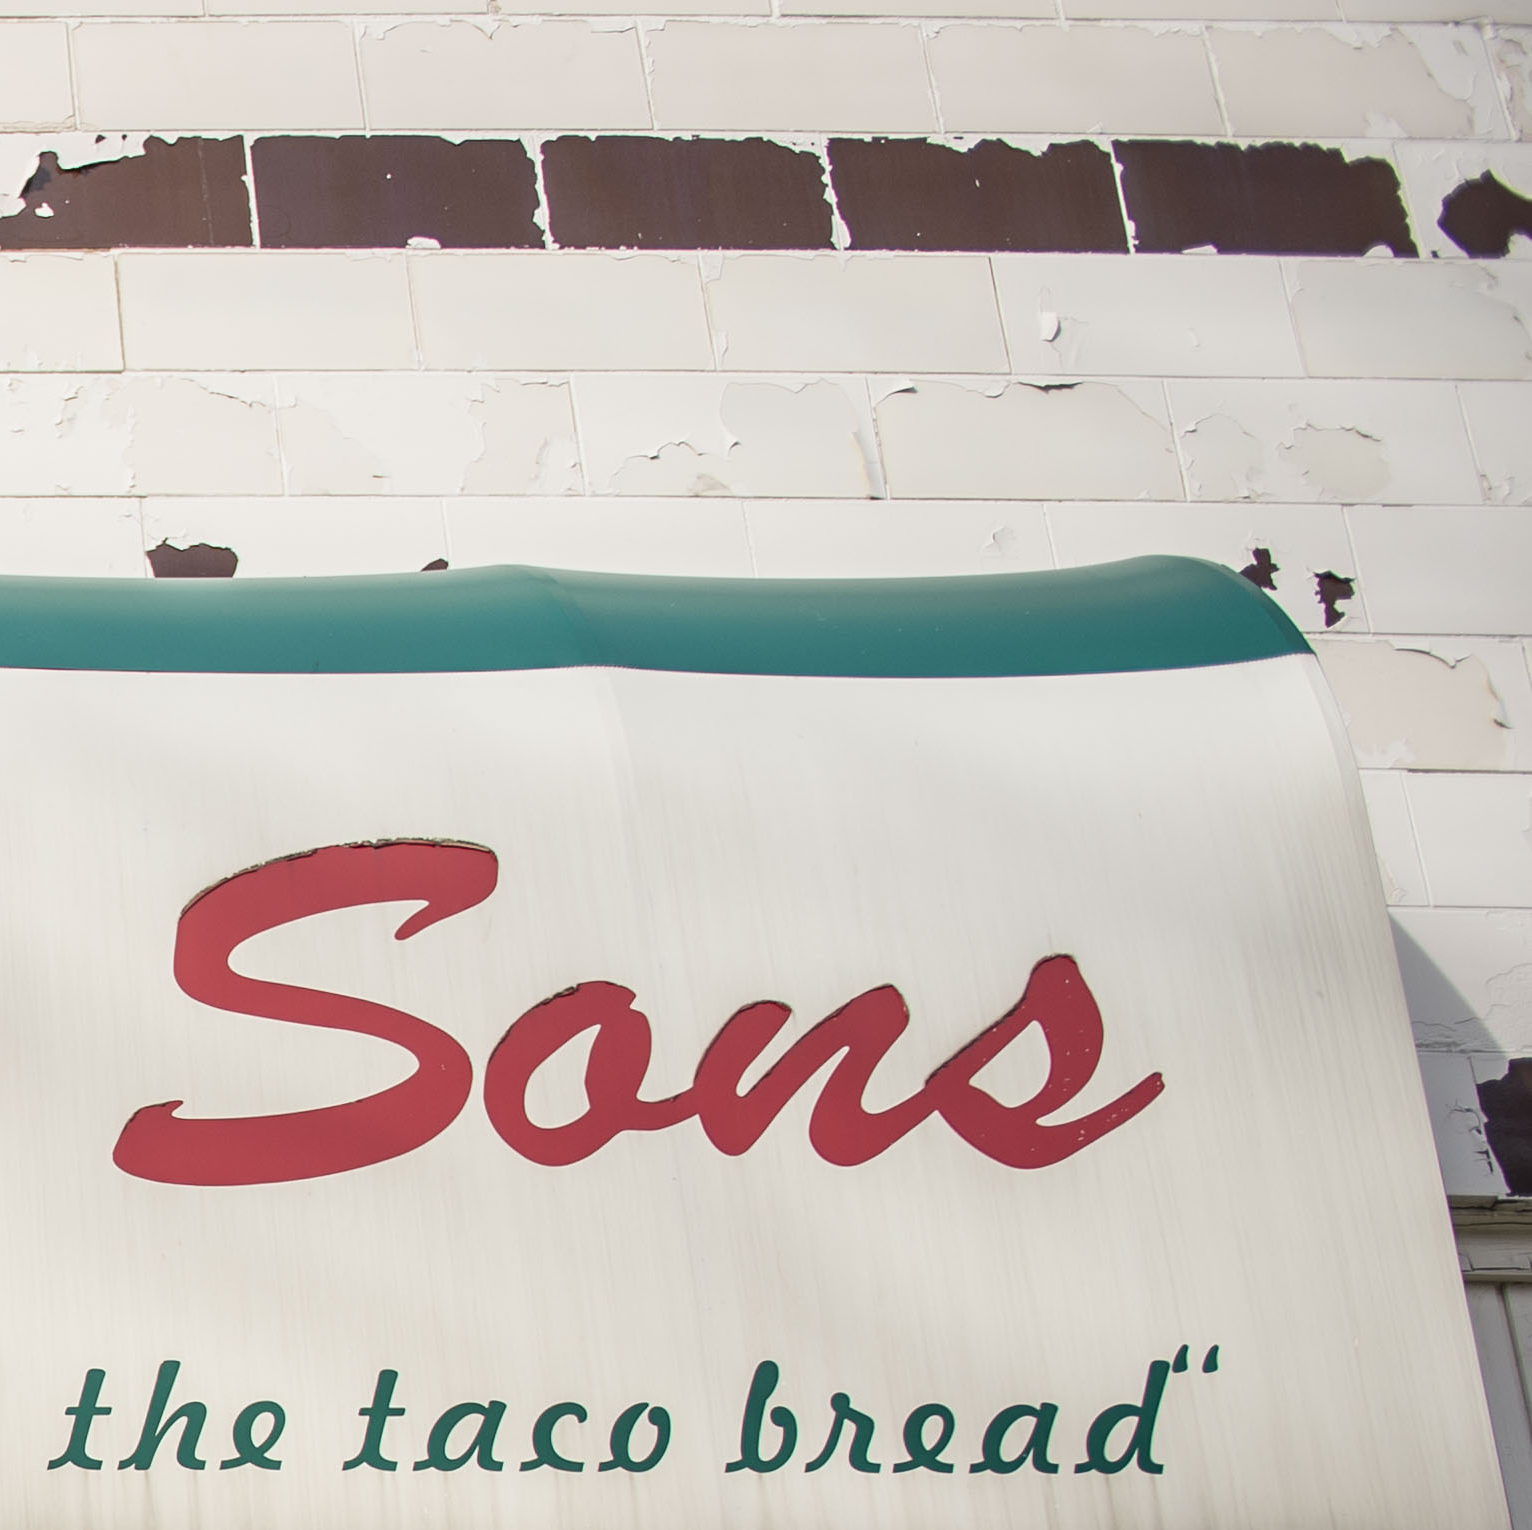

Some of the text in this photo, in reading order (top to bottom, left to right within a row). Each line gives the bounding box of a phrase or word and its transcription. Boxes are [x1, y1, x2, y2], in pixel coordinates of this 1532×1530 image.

[114, 840, 1165, 1187] Sons
[48, 1360, 286, 1470] the
[343, 1369, 672, 1473] taco
